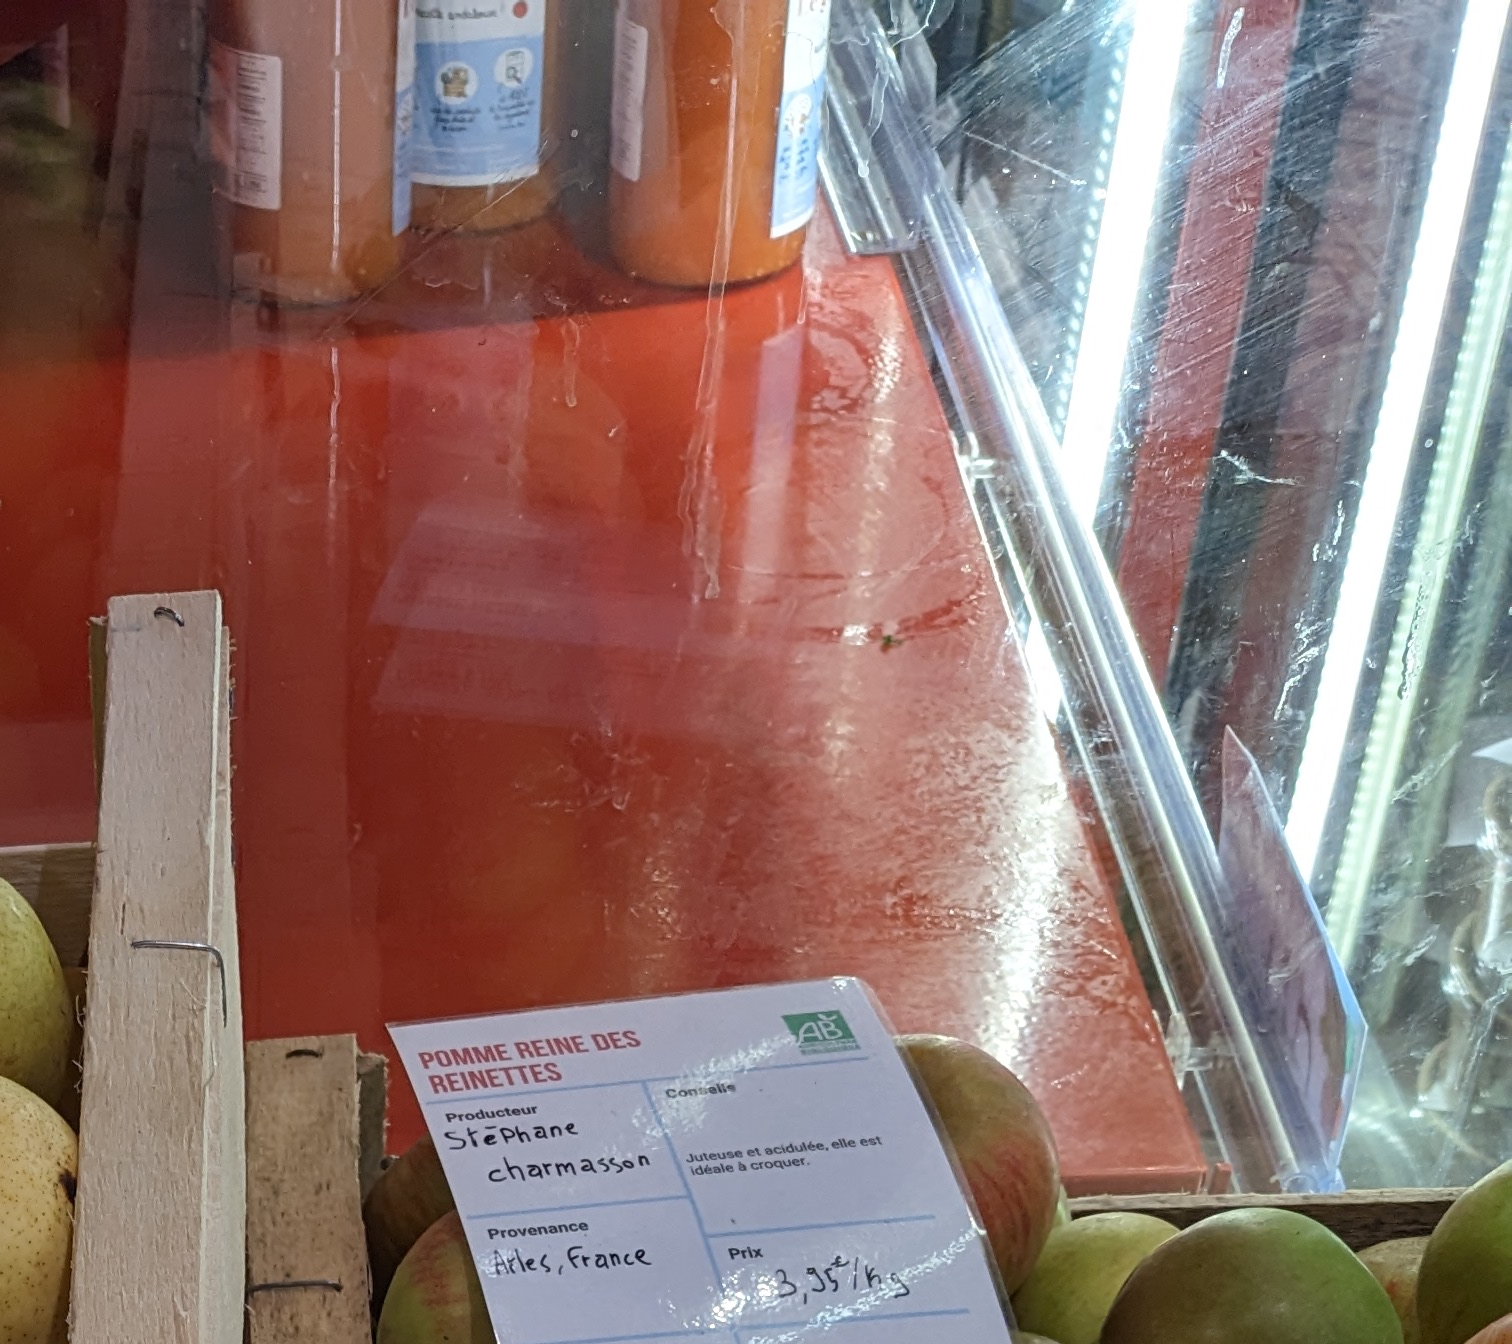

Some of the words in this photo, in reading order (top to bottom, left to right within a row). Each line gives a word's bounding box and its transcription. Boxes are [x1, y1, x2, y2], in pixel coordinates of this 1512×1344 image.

[798, 1019, 844, 1046] AB
[417, 1043, 513, 1070] POMME
[513, 1035, 590, 1060] REINE
[590, 1030, 642, 1052] DES
[427, 1062, 563, 1095] REINETTES
[444, 1105, 538, 1123] Producteur
[486, 1221, 589, 1240] Provenance
[566, 1245, 652, 1270] France
[727, 1246, 764, 1261] Prix
